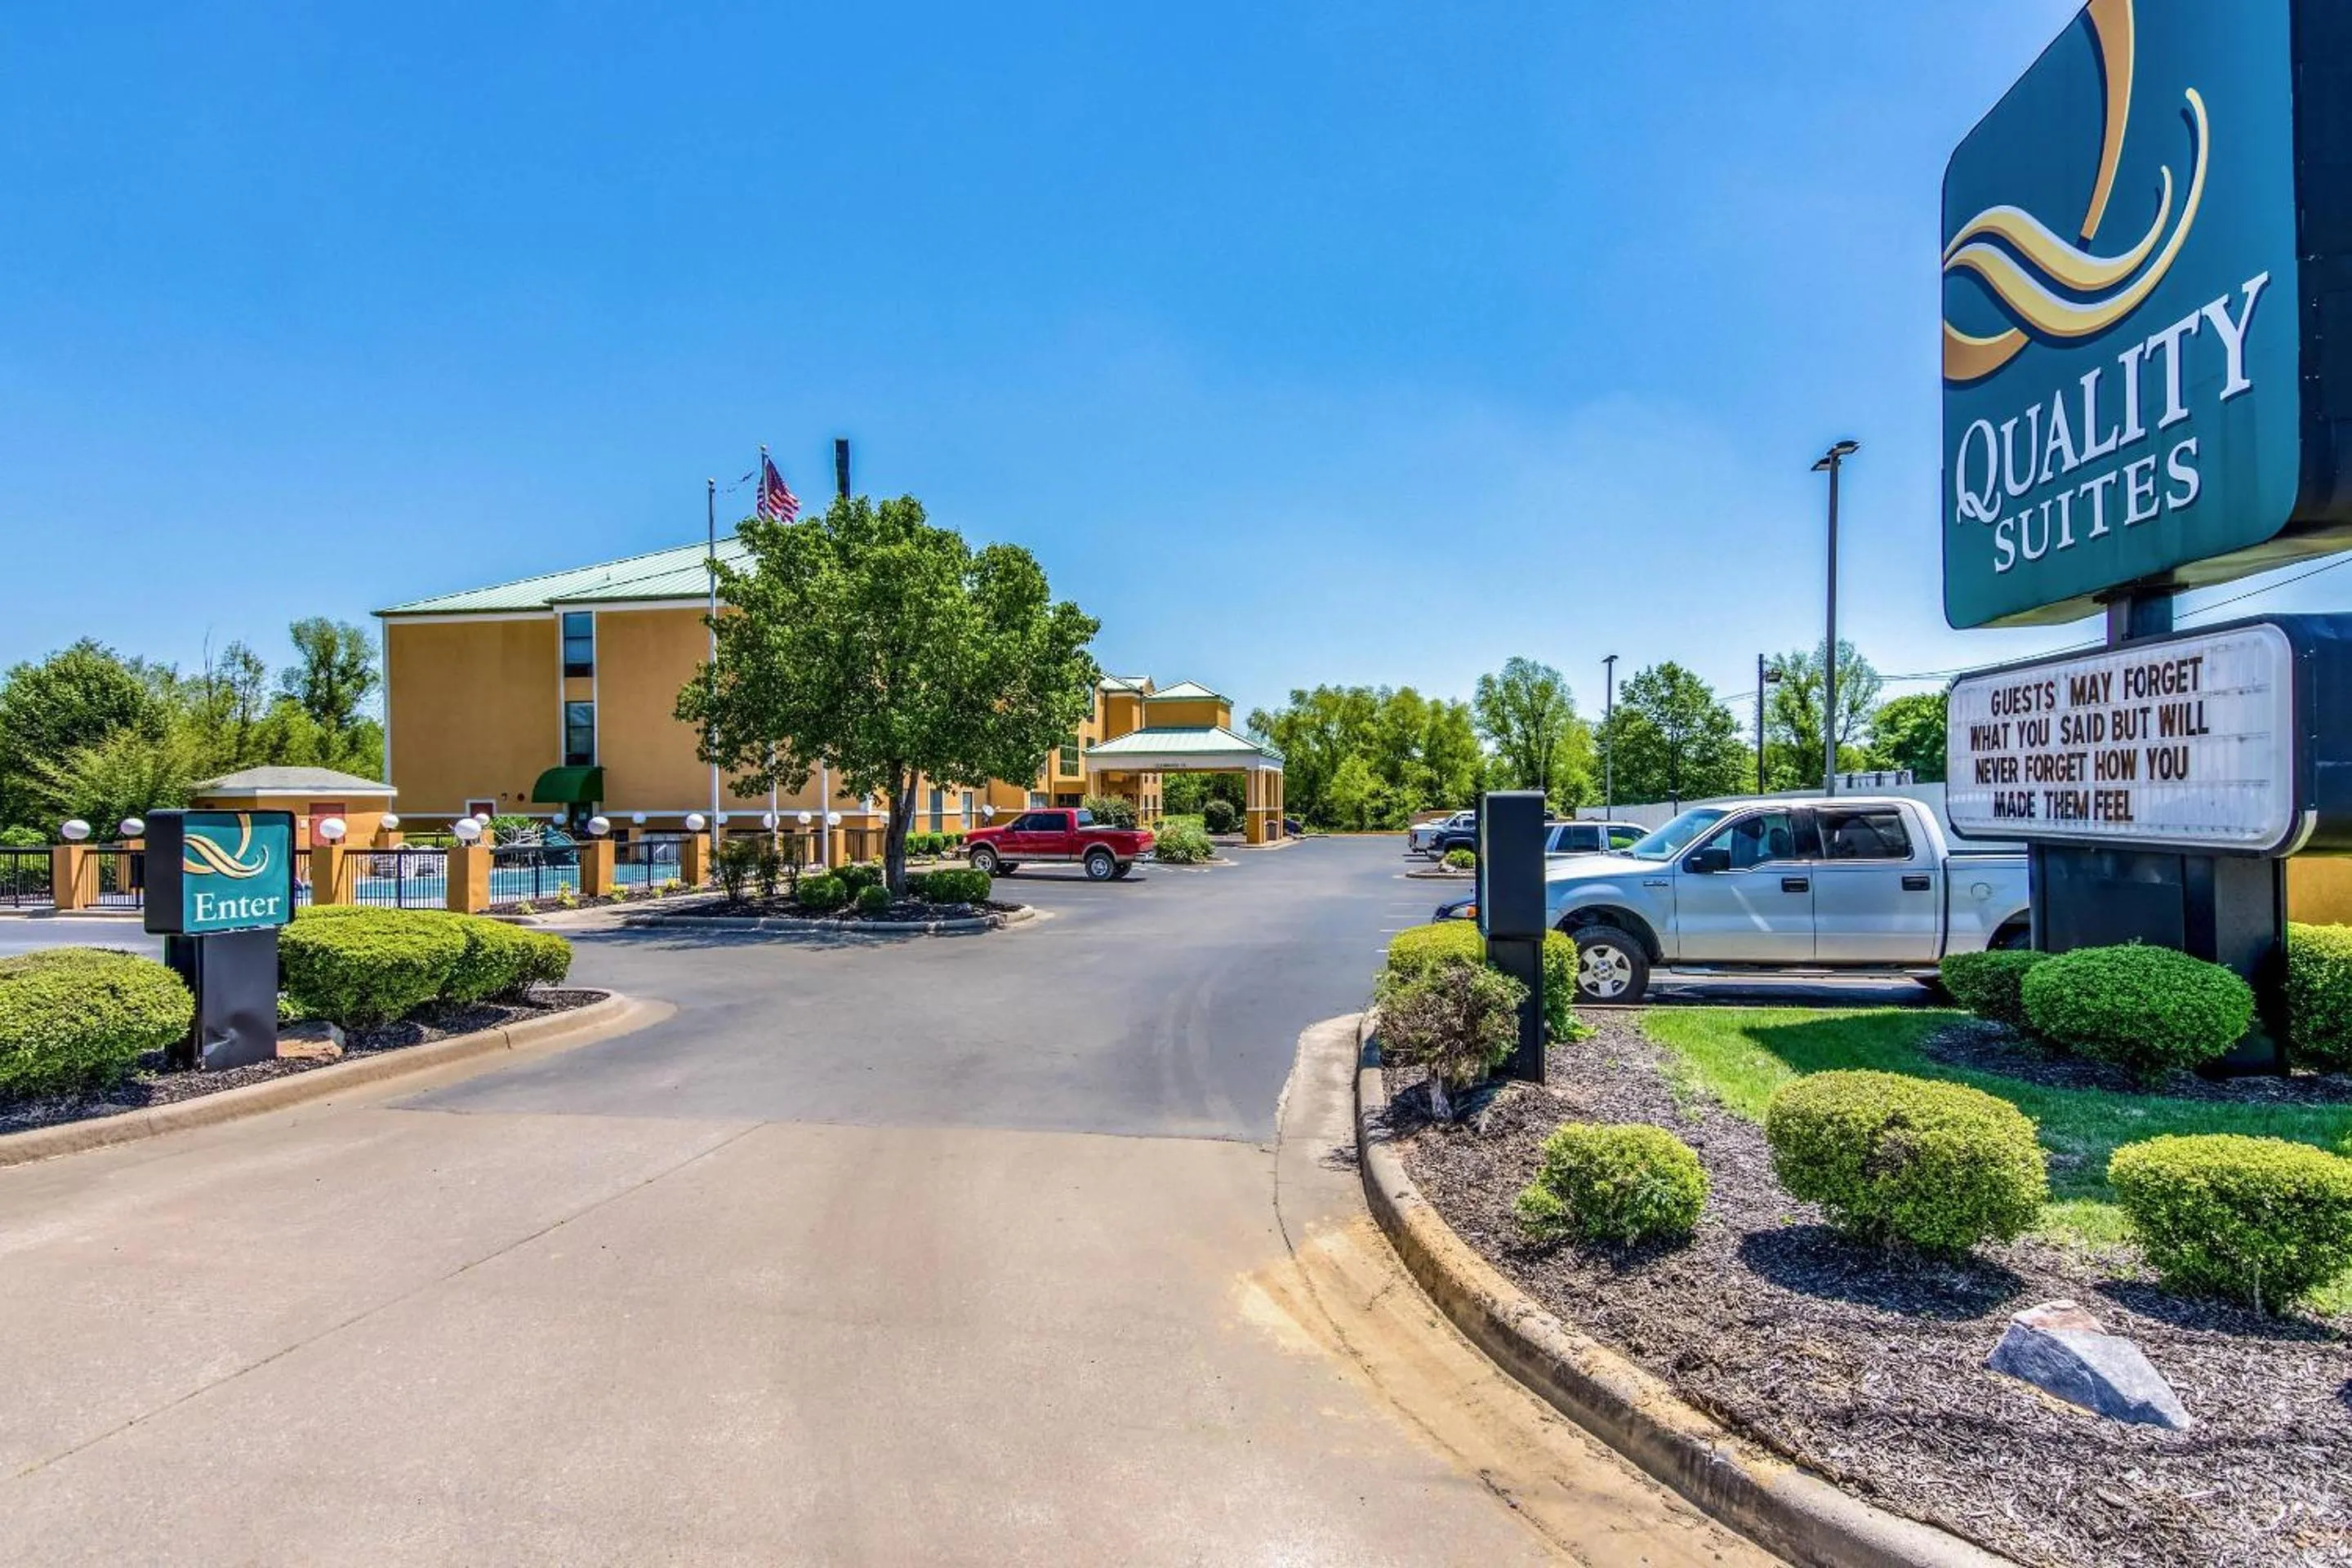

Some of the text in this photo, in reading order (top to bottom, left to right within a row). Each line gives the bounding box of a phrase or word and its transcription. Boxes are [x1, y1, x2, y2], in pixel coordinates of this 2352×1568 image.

[1956, 271, 2268, 523] QUALITY
[1994, 437, 2200, 572] SUITES
[1991, 657, 2203, 715] GUESTS MAY FORGET
[1971, 702, 2208, 751] WHAT YOU SAID BUT WILL
[1976, 746, 2189, 784] NEVER FORGET HOW YOU
[1994, 790, 2133, 822] MADE THEM FEEL
[194, 893, 279, 921] Enter
